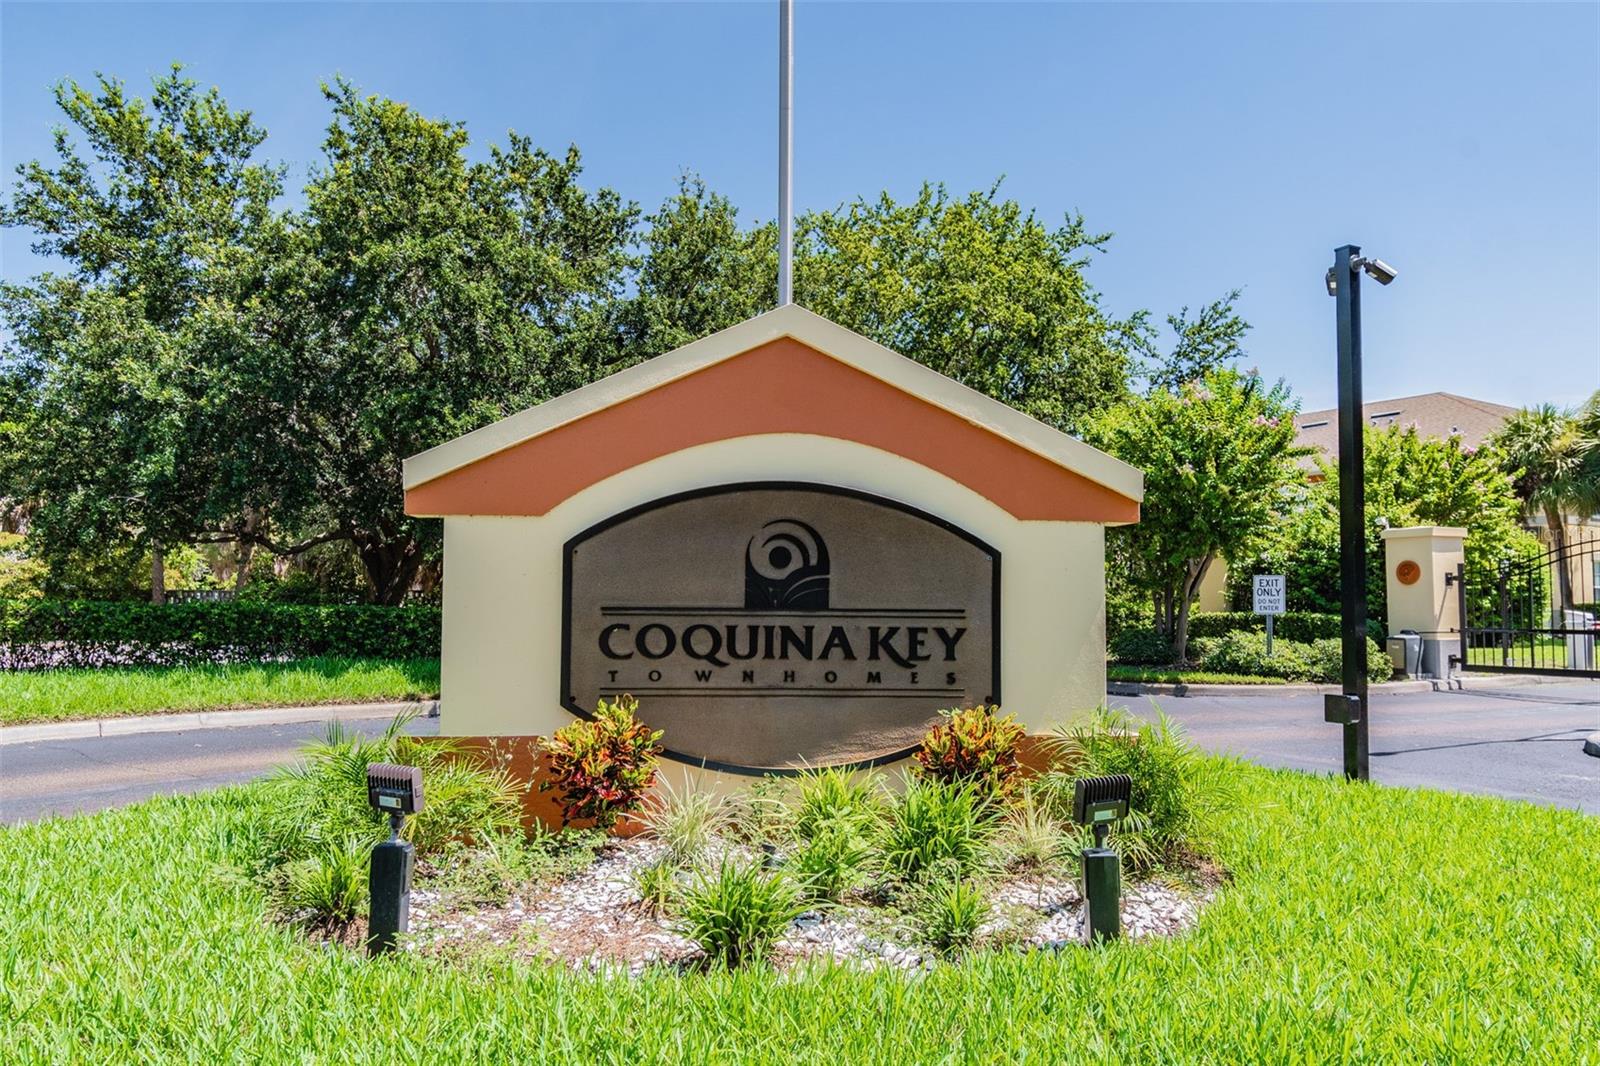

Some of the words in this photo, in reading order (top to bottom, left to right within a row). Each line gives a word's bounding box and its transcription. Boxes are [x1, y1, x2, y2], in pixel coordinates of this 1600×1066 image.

[1259, 579, 1279, 587] EXIT
[1257, 588, 1281, 596] ONLY
[598, 623, 857, 667] COQUINA
[867, 625, 967, 669] KEY
[608, 669, 957, 685] TOWNHOMES
